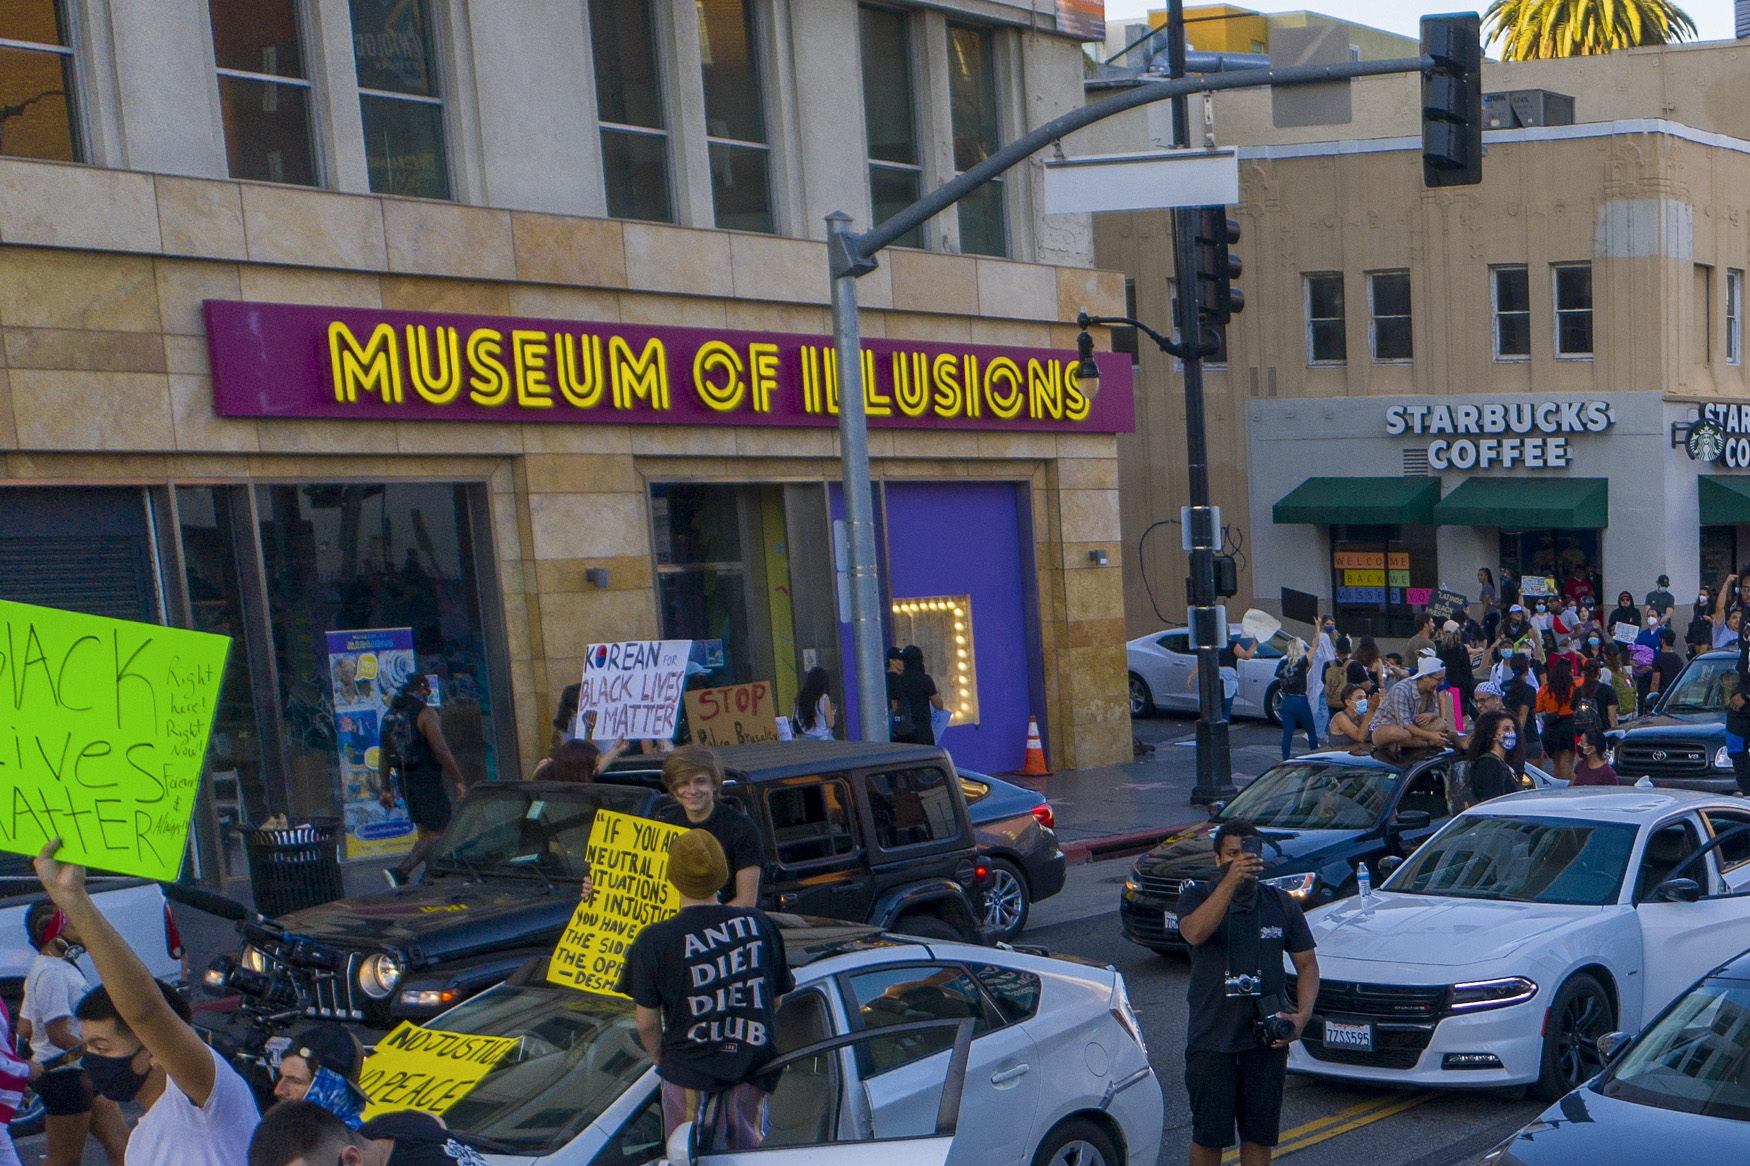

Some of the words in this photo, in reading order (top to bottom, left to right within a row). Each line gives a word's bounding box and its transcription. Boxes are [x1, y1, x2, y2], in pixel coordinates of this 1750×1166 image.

[327, 319, 670, 412] MUSEUM
[692, 339, 780, 412] OF
[801, 345, 1092, 423] ILLUSIONS
[1385, 401, 1612, 434] STARBUCKS
[1427, 437, 1569, 469] COFFEE
[1335, 557, 1406, 567] WELCOME
[1347, 574, 1383, 583] BACK
[1390, 575, 1407, 584] WE
[1408, 592, 1426, 602] YO
[663, 655, 677, 667] FOR
[0, 620, 158, 736] lACK
[580, 674, 632, 710] BLACK
[641, 670, 684, 703] LIVES
[700, 683, 766, 721] STOP
[602, 704, 674, 736] MATTER
[633, 822, 660, 853] YOU
[661, 831, 679, 853] AR
[588, 845, 653, 879] NEUTRAL
[565, 929, 595, 949] THE
[576, 910, 599, 928] YOU
[600, 918, 637, 938] HAVE
[684, 916, 759, 960] ANTI
[557, 947, 585, 969] THE
[690, 941, 763, 988] DIET
[687, 977, 764, 1017] DIET
[388, 1027, 432, 1052] NO
[688, 1017, 767, 1047] CLUB
[1327, 1028, 1369, 1046] 7ZSS595
[380, 1071, 475, 1112] PEACE
